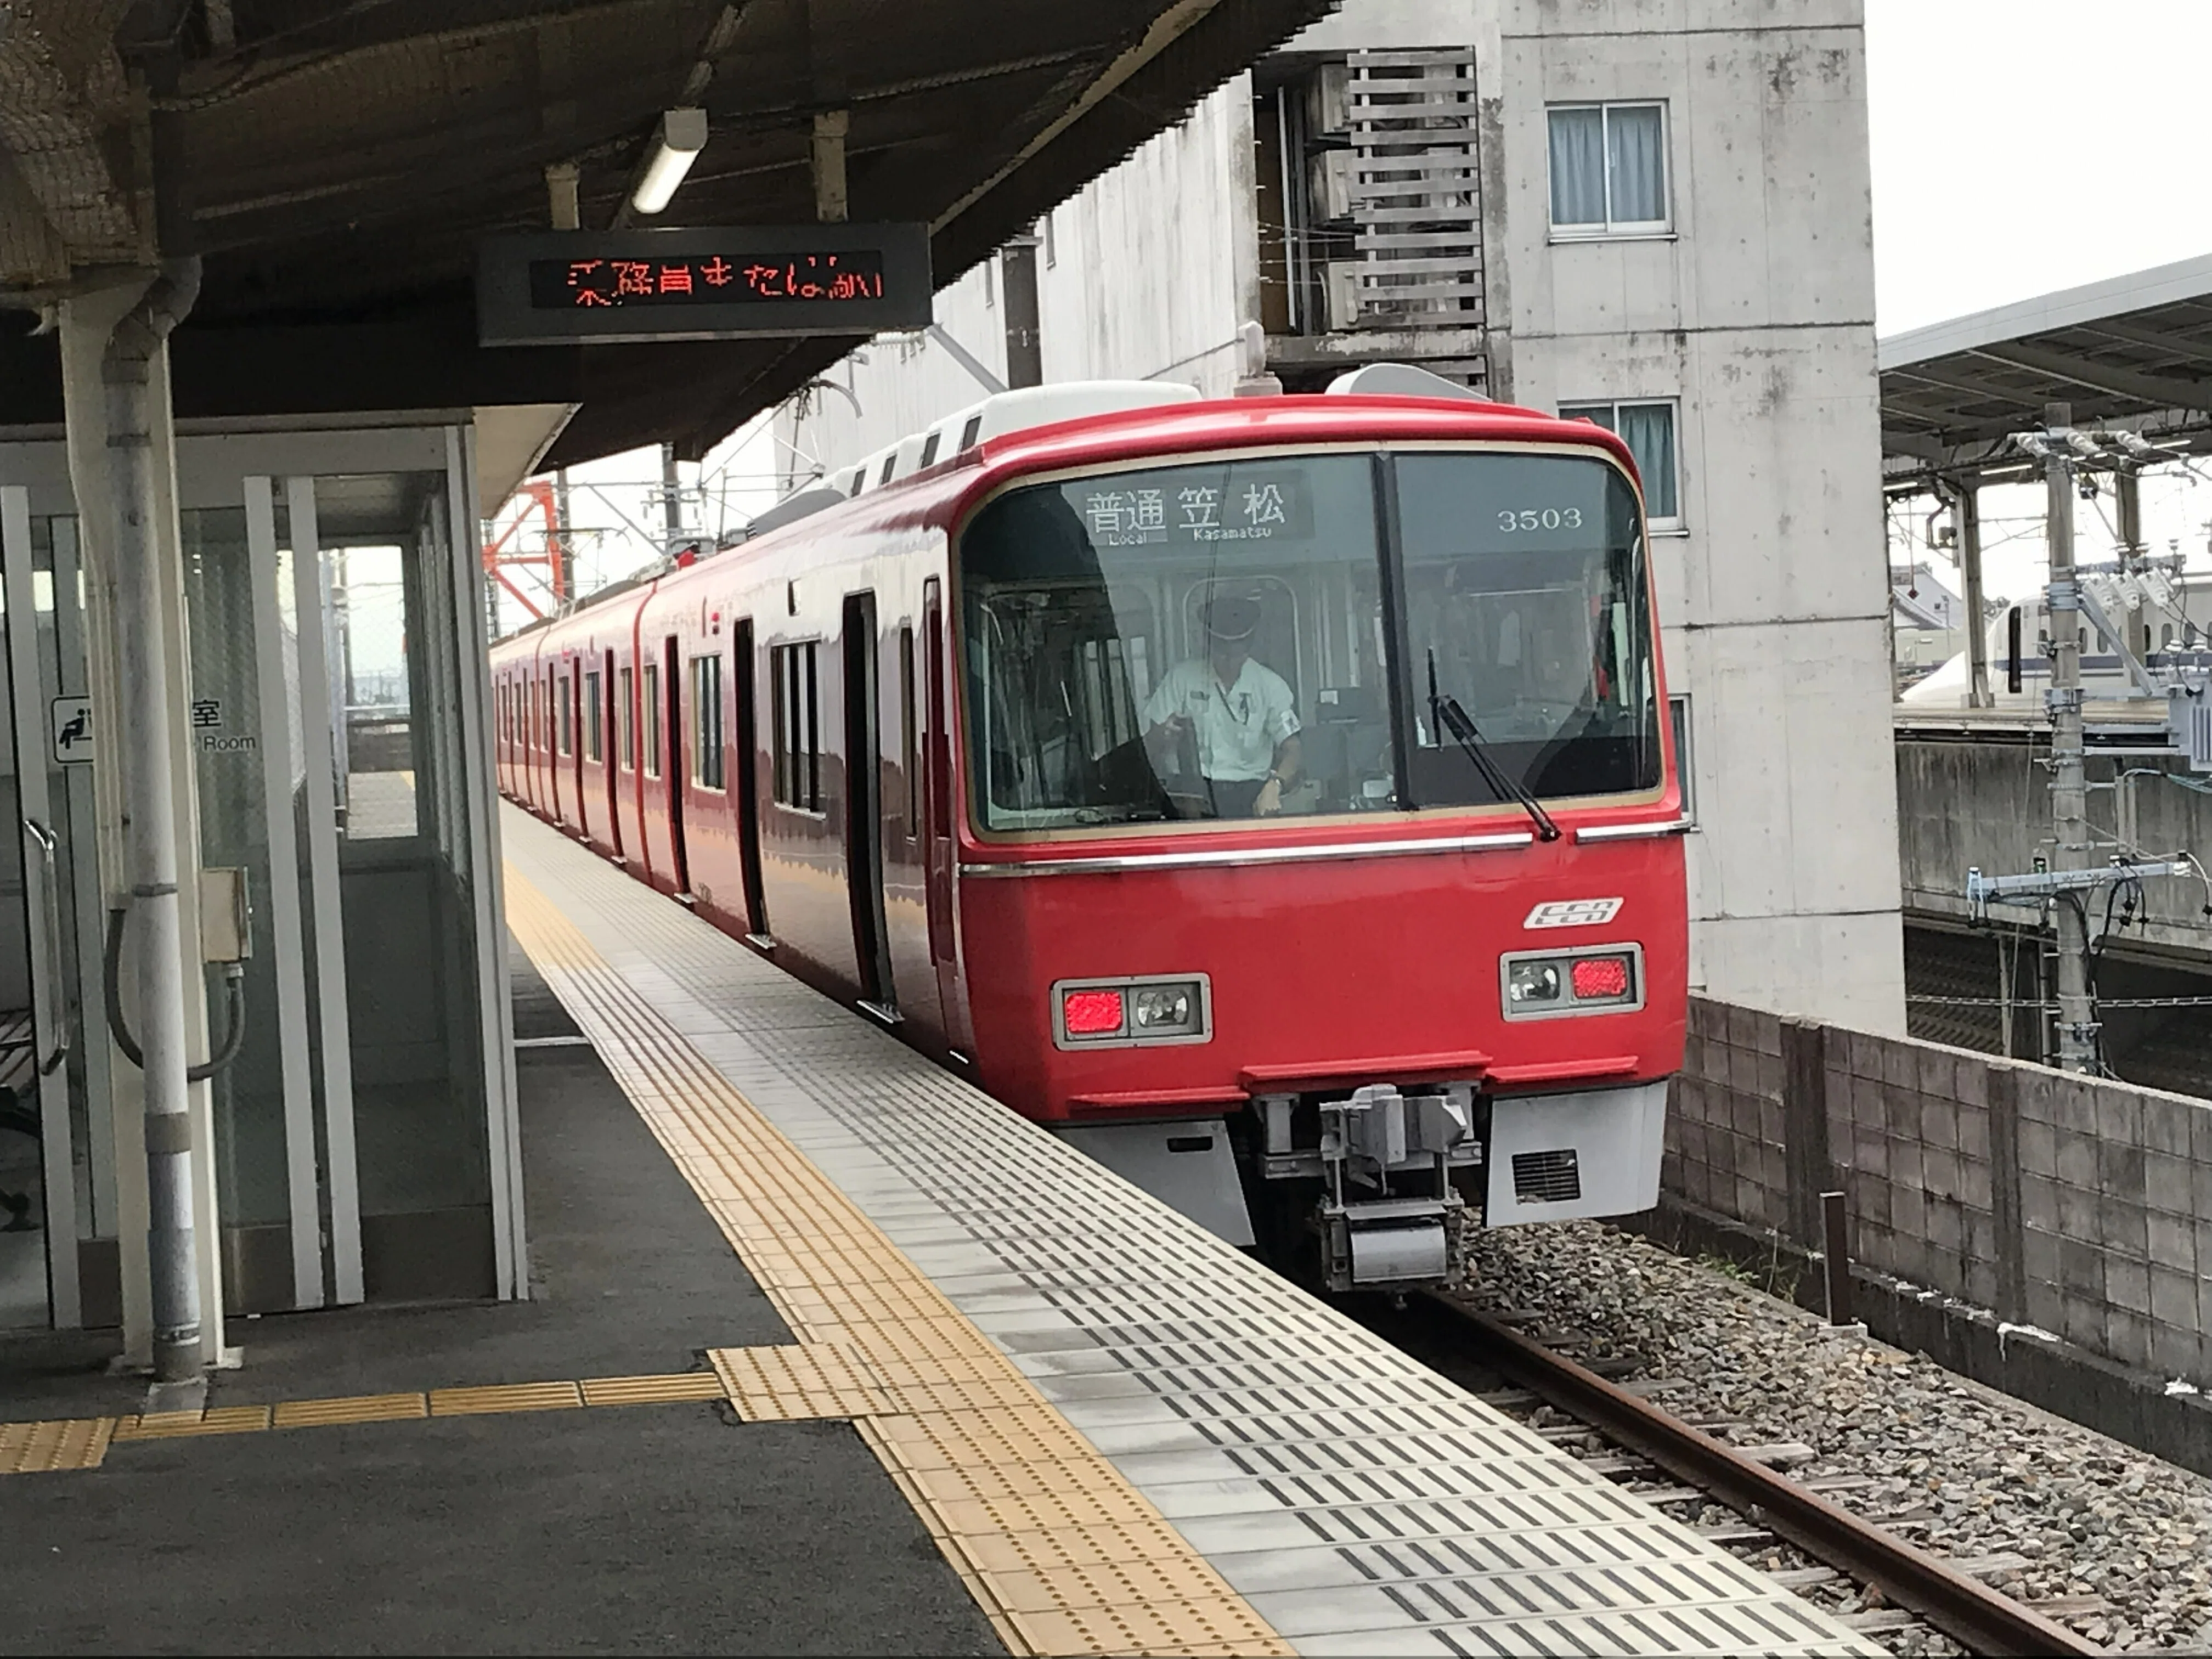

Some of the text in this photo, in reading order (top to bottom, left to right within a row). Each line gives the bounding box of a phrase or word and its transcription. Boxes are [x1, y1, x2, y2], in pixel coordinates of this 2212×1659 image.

[1086, 483, 1285, 532] 普通 笠松
[1497, 507, 1582, 532] 3503
[1108, 527, 1272, 545] Local Kasamatsu
[204, 736, 256, 751] Room
